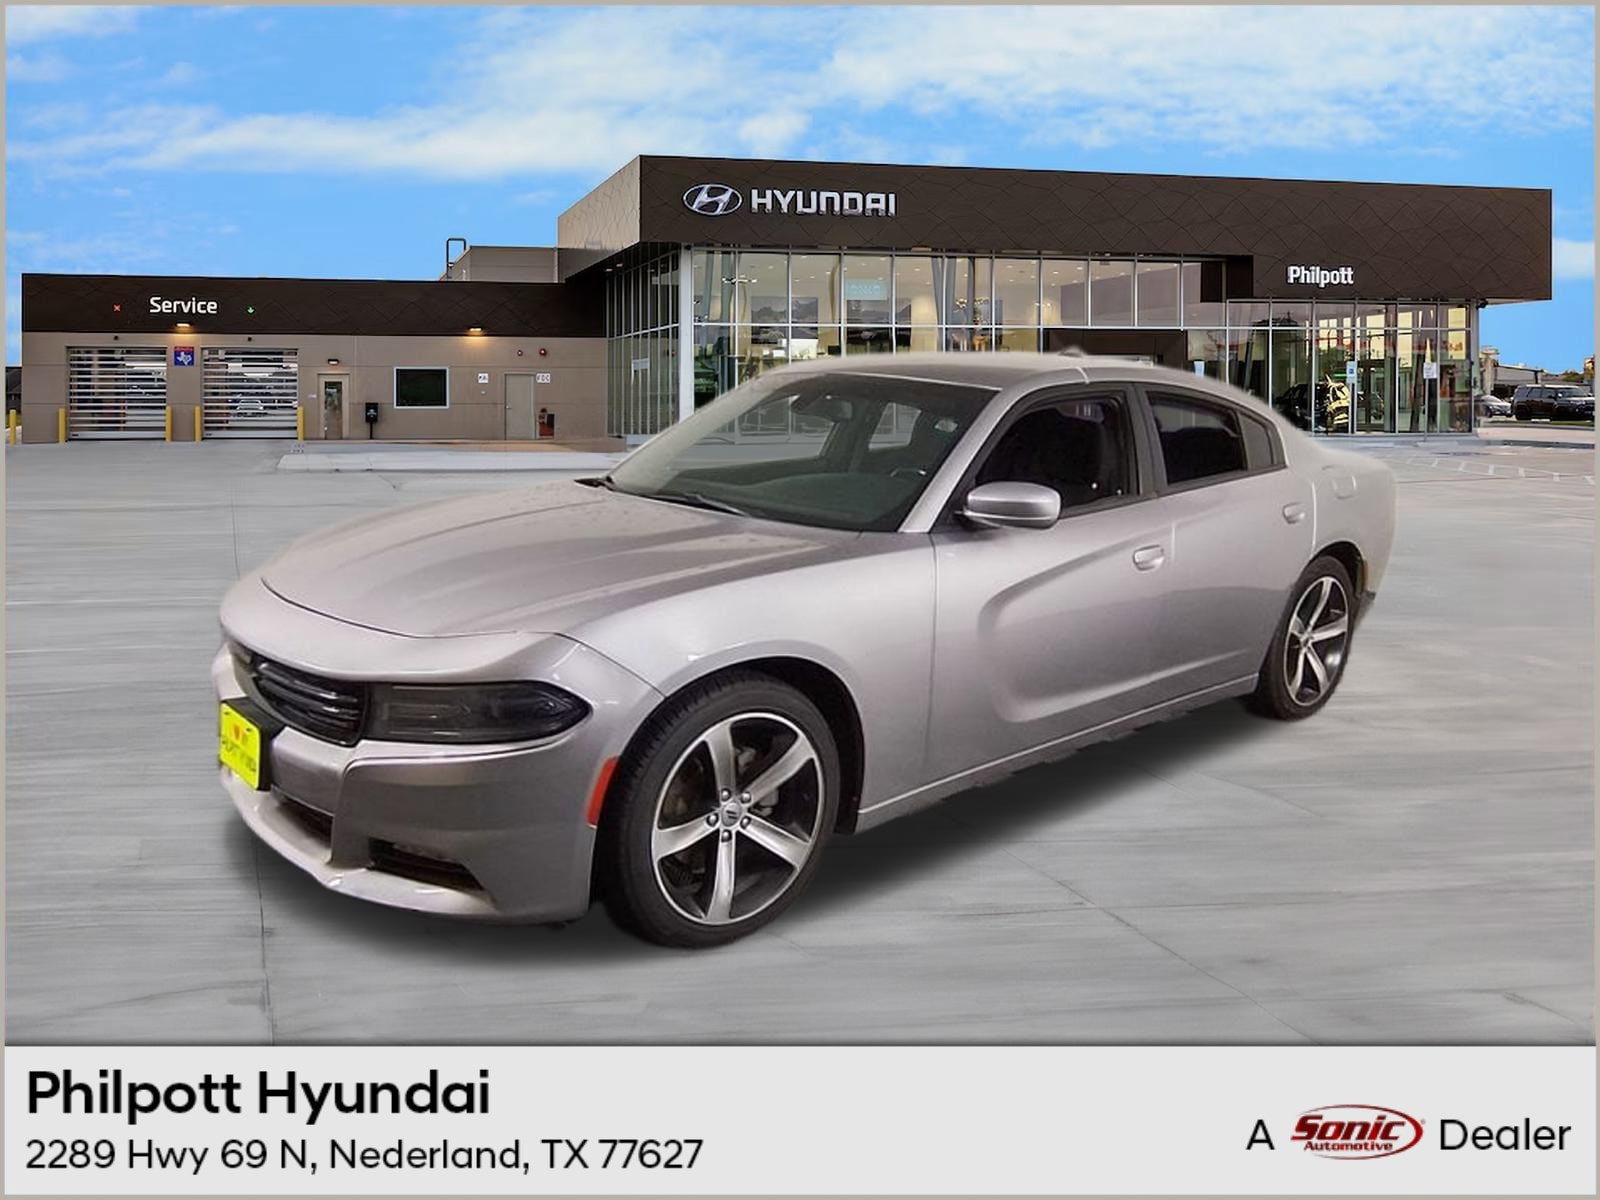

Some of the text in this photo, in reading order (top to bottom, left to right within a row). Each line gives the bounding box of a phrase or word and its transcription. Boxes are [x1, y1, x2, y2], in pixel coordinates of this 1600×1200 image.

[750, 188, 897, 217] HYUNDAI
[1287, 265, 1355, 288] Philpott
[149, 296, 218, 315] Service
